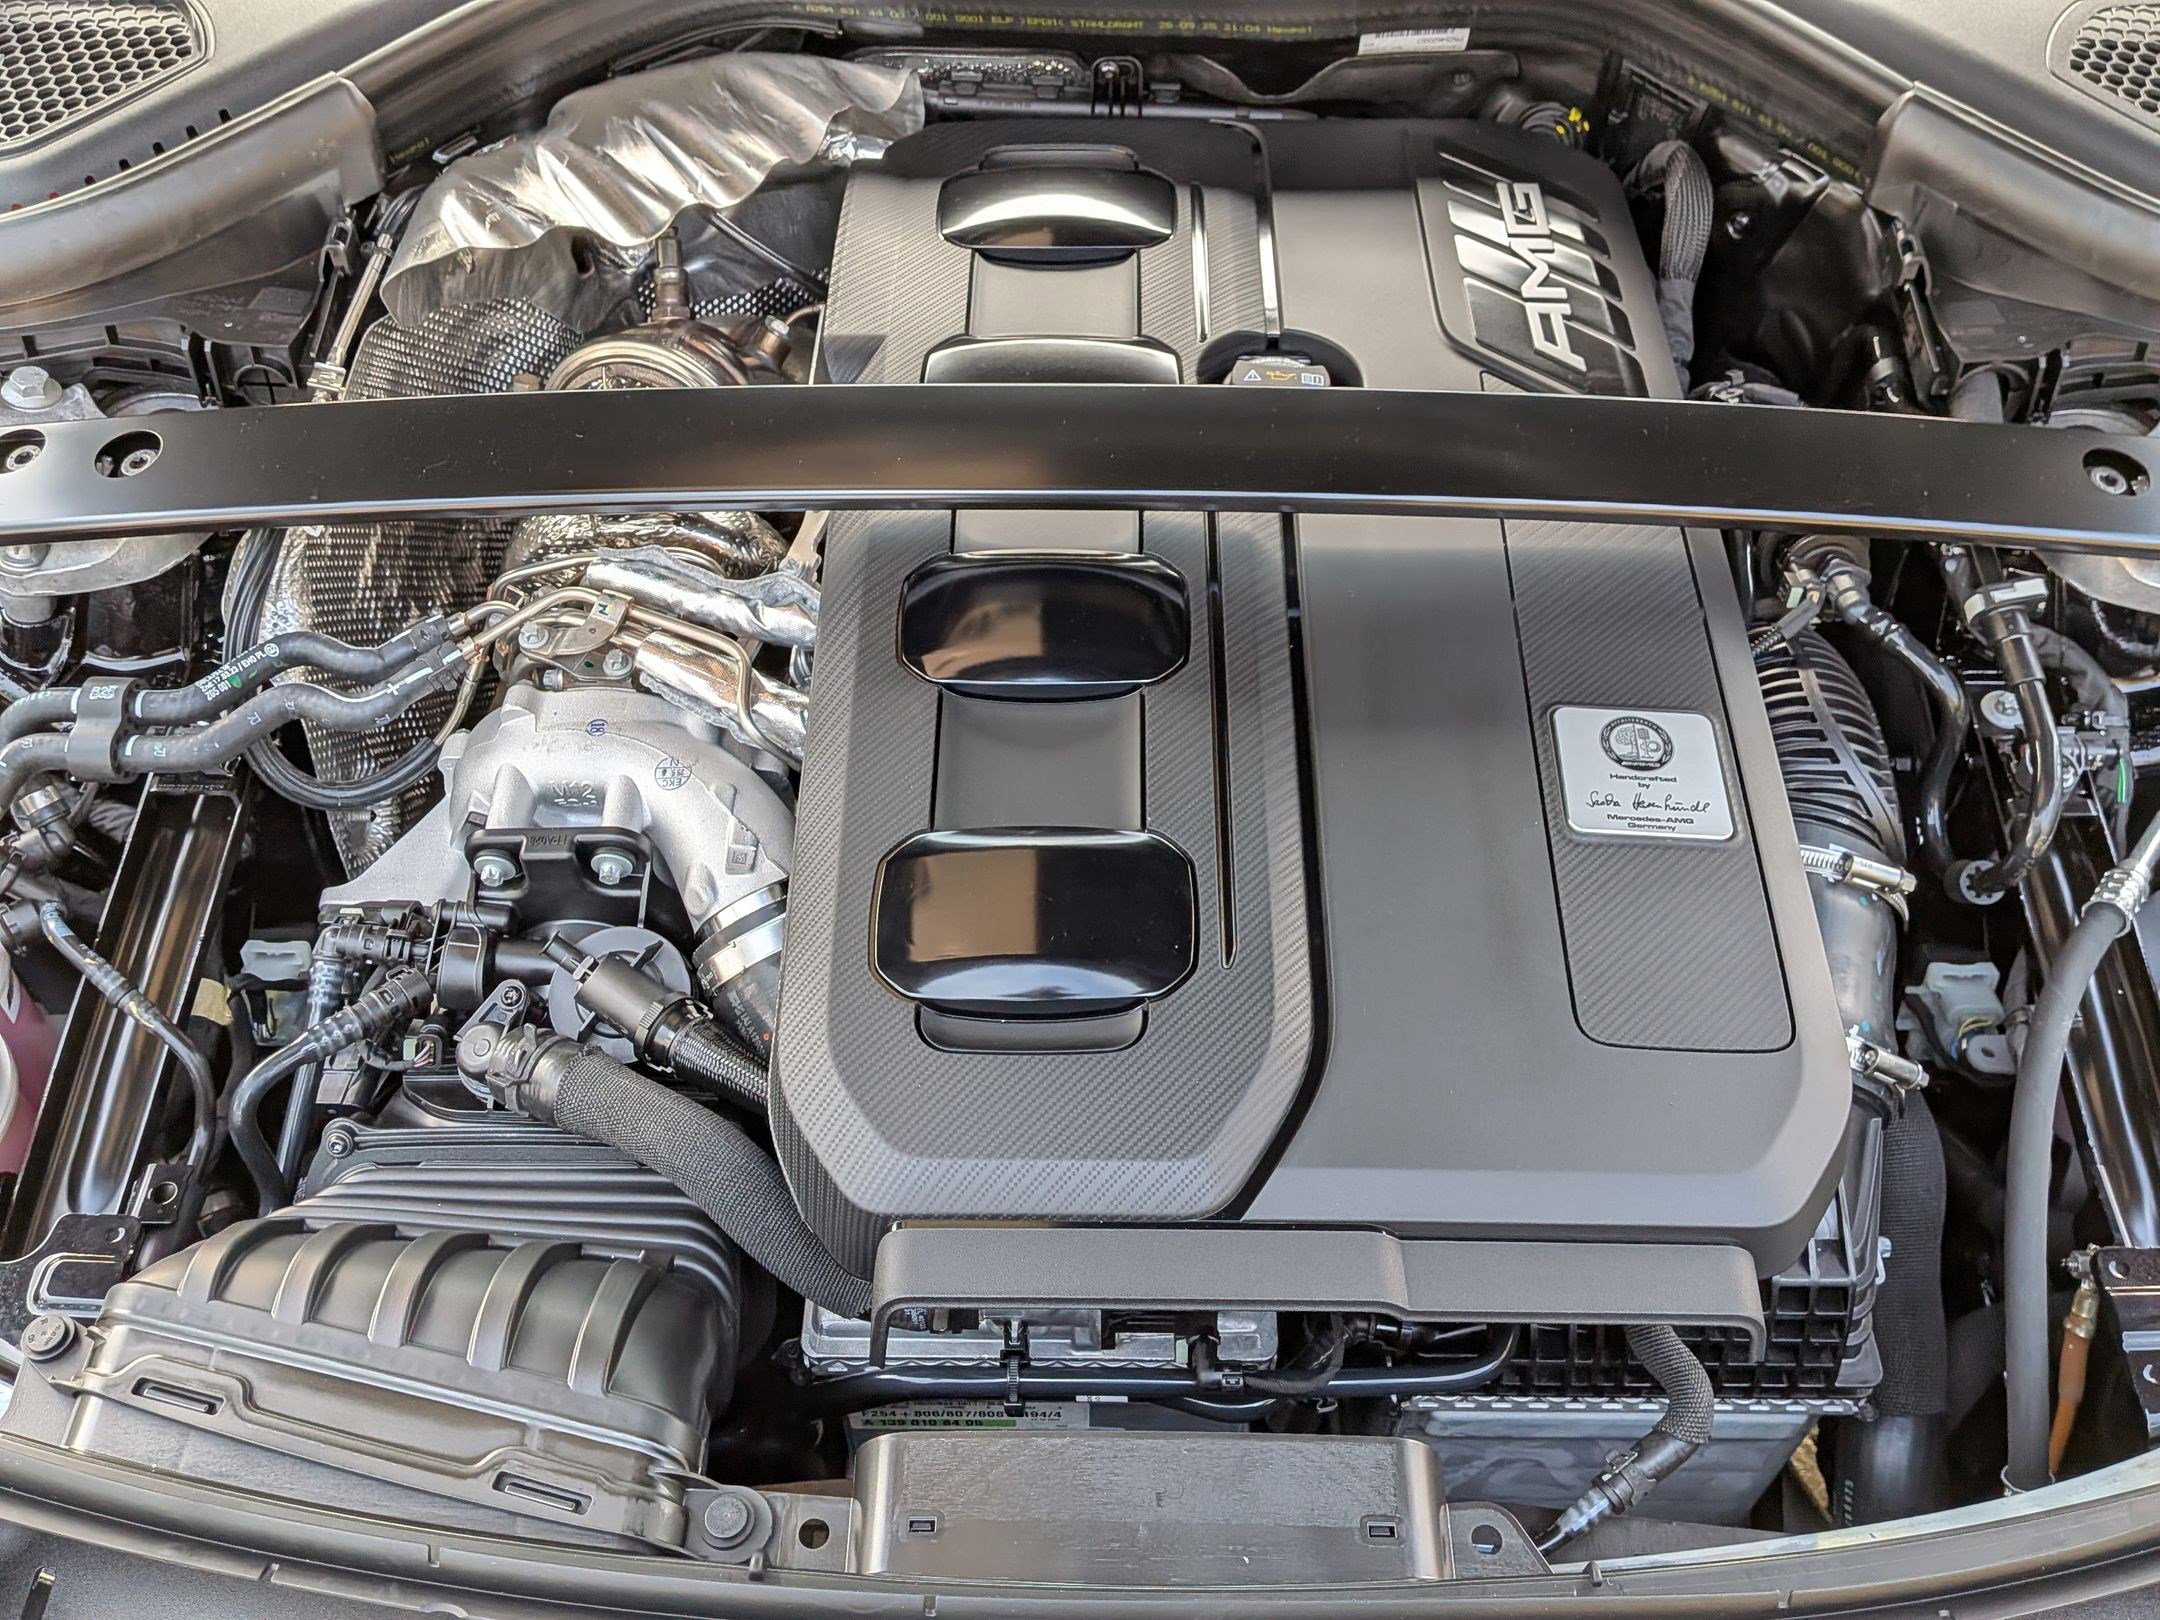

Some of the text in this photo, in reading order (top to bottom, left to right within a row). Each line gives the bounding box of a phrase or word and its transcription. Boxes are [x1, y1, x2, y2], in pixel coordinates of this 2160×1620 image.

[1497, 182, 1588, 372] AMG
[1609, 773, 1677, 783] Handcrafted
[1637, 781, 1651, 790] by
[1607, 813, 1695, 825] Mercedes-AMG
[1627, 822, 1677, 832] Germany
